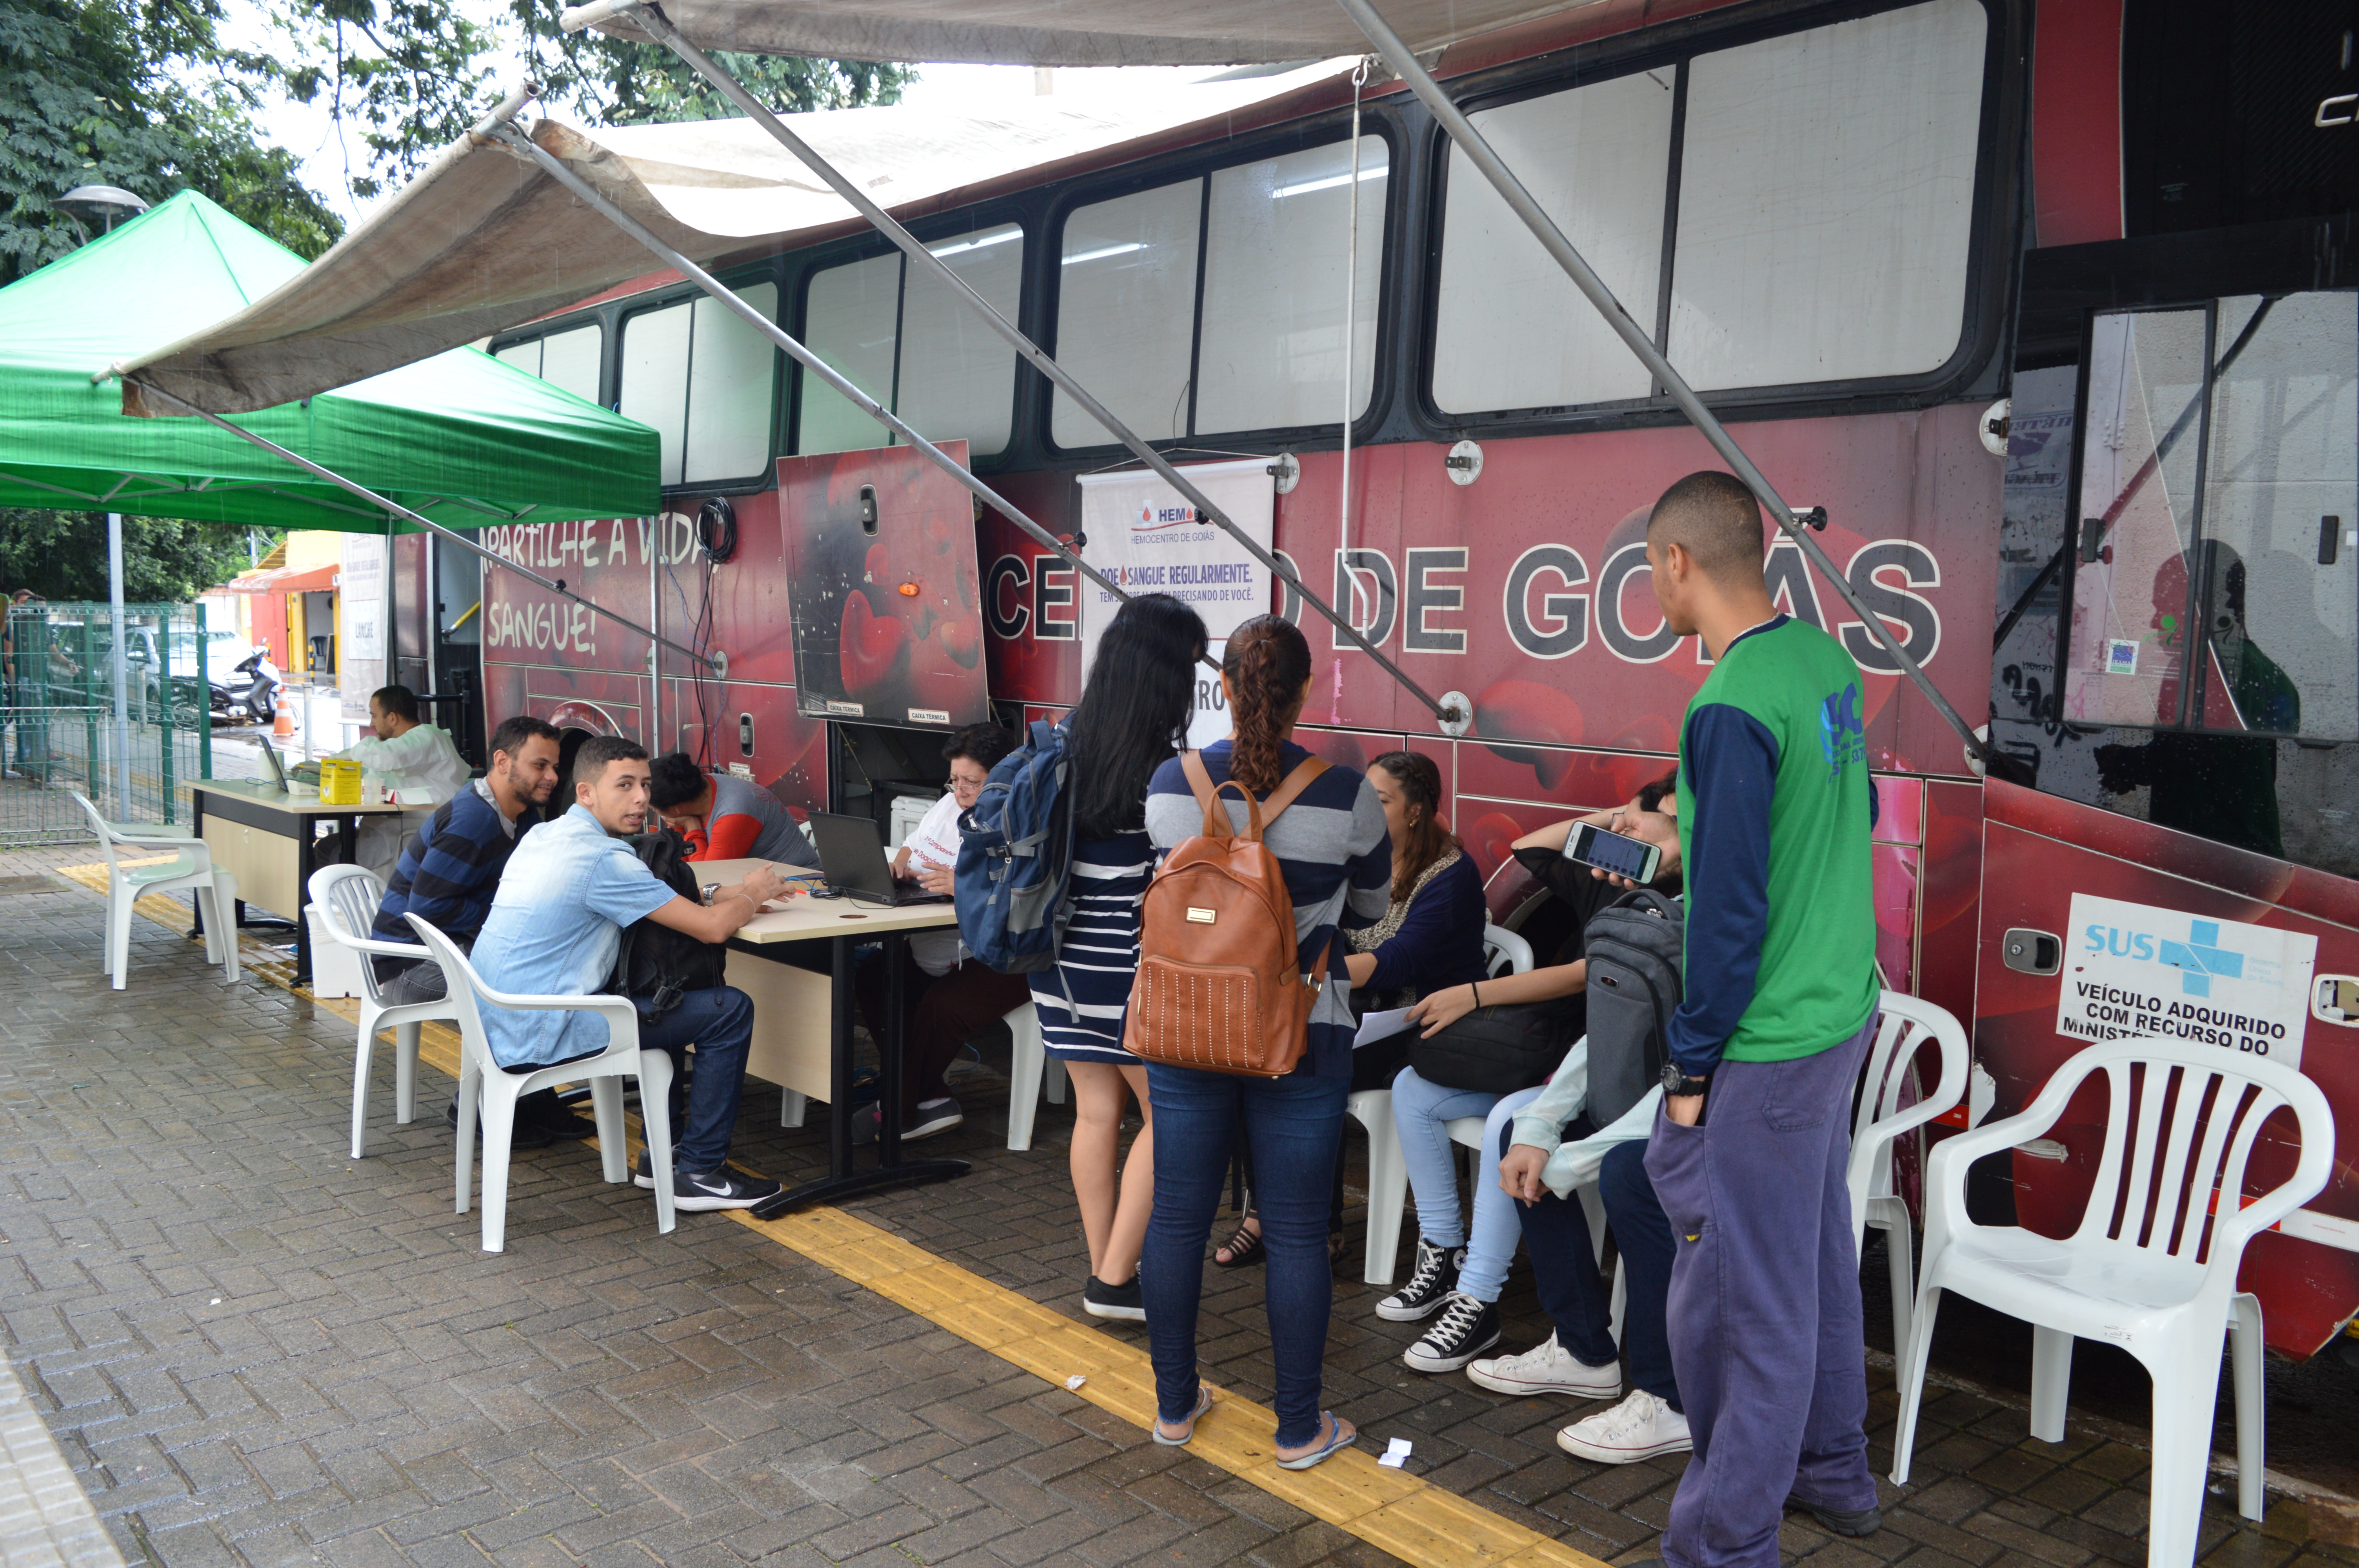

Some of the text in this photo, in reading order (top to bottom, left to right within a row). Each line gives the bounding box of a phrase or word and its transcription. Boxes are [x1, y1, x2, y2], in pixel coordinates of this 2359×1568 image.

[2315, 93, 2359, 127] C
[608, 519, 627, 565] A
[1131, 530, 1214, 544] HEMOCENTRO DE GOIÁS
[1101, 563, 1253, 586] DOE SANGUE REGULARMENTE.
[1332, 547, 1468, 654] DE
[1503, 507, 1941, 675] GOÁS
[1100, 592, 1114, 603] TEM
[1216, 590, 1229, 601] DE
[1231, 587, 1254, 601] VOCÊ.
[488, 596, 596, 655] SANGUE!
[927, 713, 946, 721] TÉRMICA
[2085, 924, 2154, 961] SUS
[2250, 956, 2281, 968] Sistema
[2077, 981, 2286, 1039] VEÍCULO ADQUIRIDO
[2086, 1002, 2269, 1056] COM RECURSO DO
